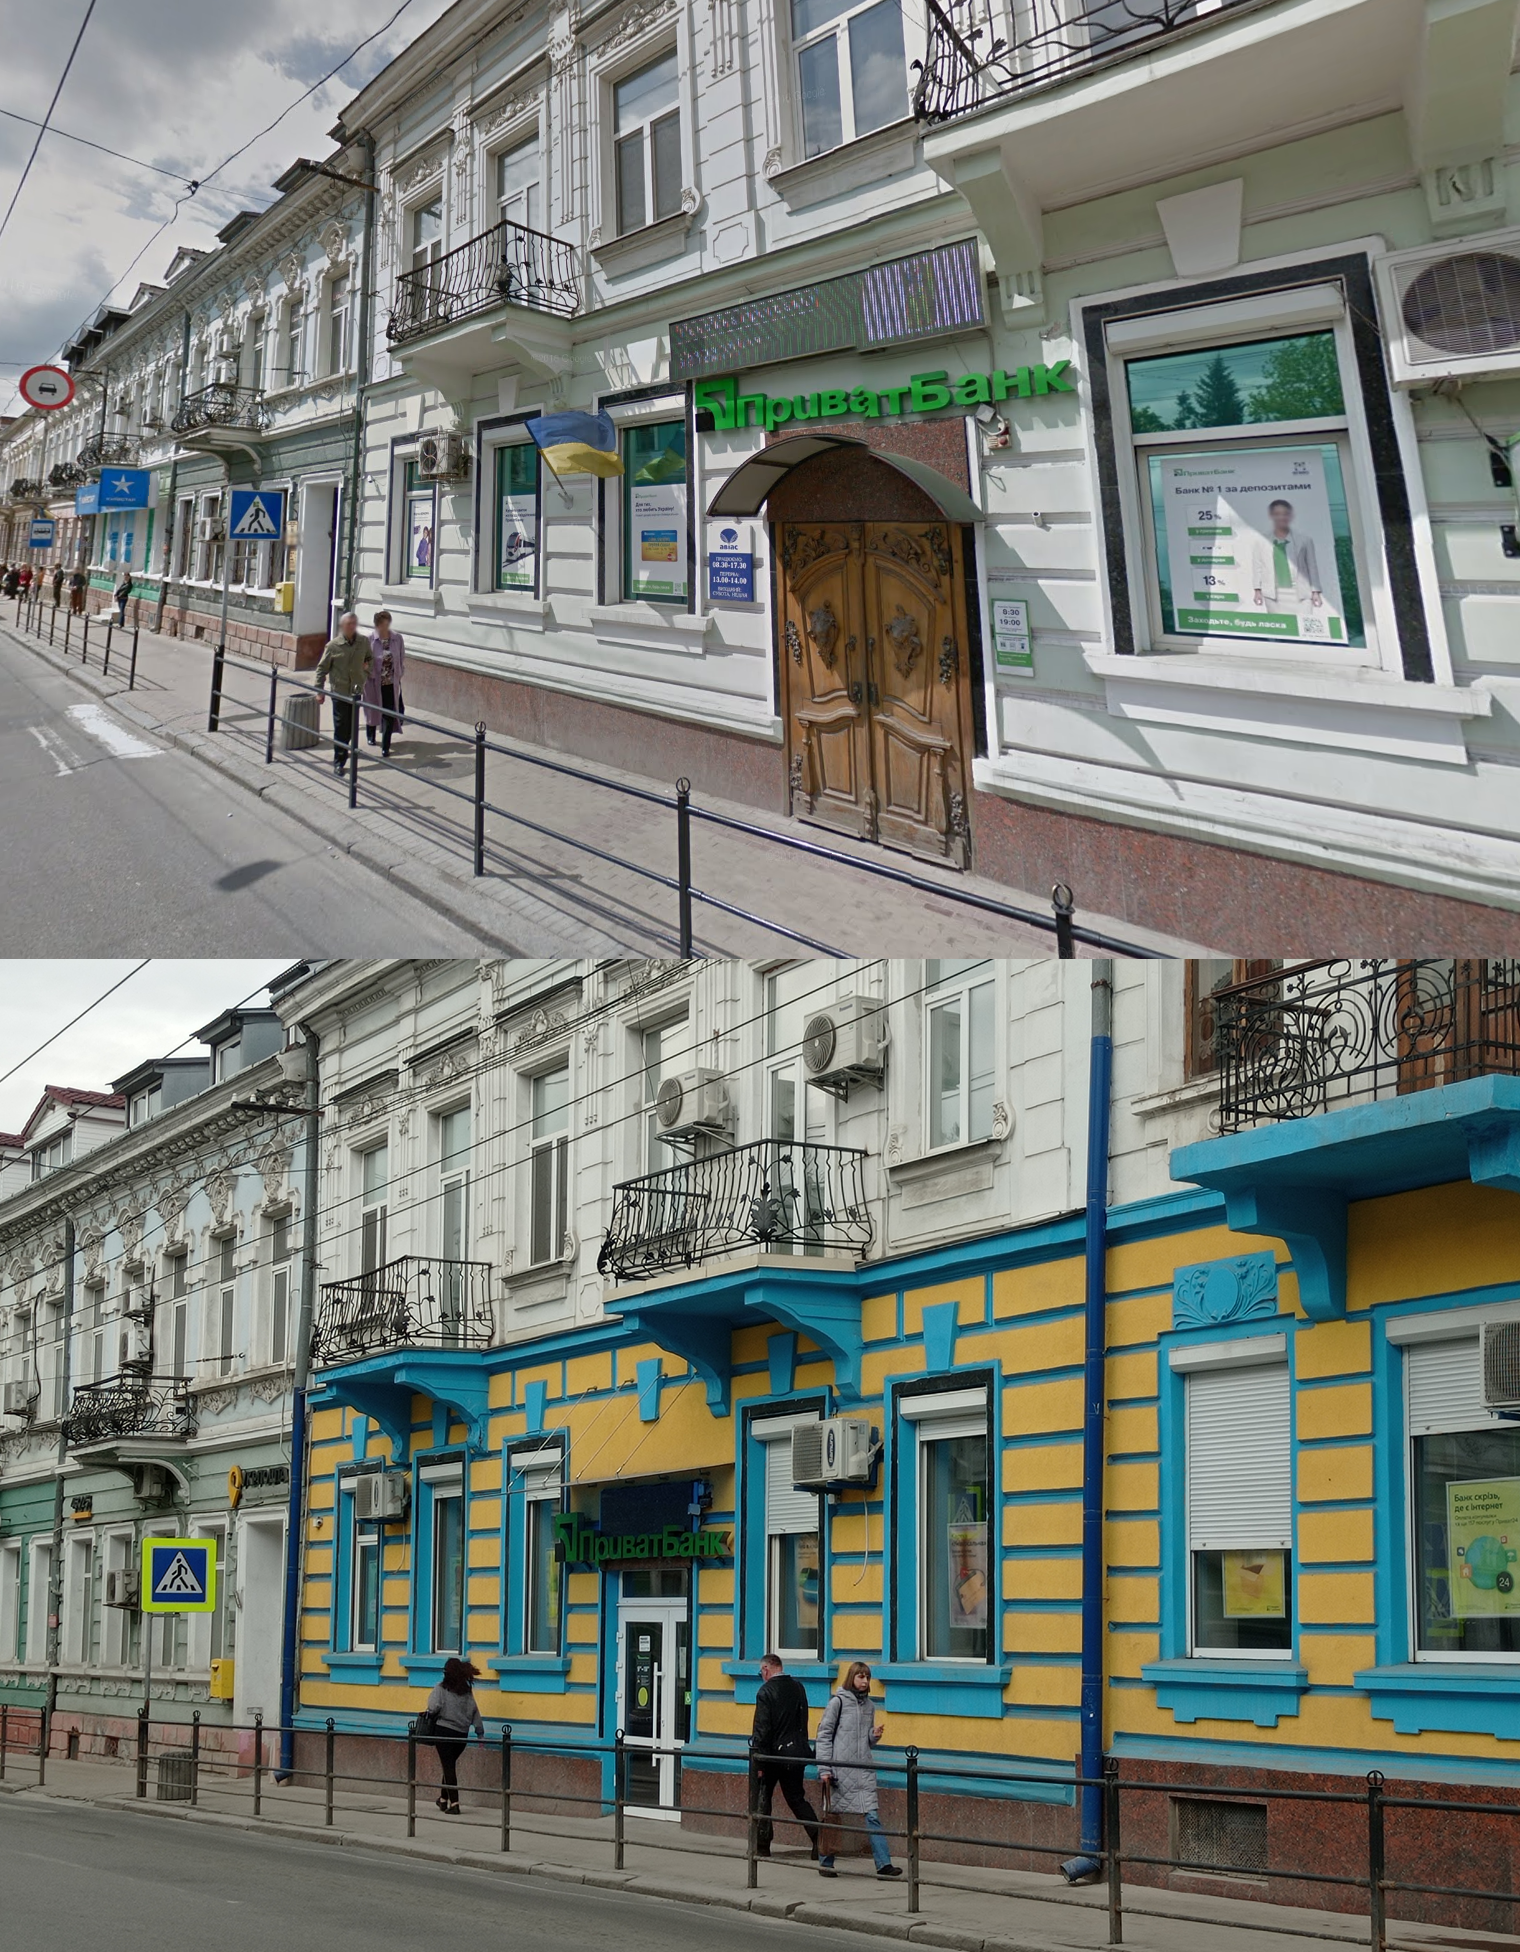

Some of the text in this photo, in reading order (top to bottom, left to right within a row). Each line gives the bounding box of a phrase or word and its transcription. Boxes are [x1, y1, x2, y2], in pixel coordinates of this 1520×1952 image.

[737, 359, 1076, 431] ПриватБанк
[1175, 486, 1200, 495] Банк
[1239, 483, 1312, 493] депозитами
[712, 561, 747, 569] 08.30-17.30
[712, 576, 747, 585] 13.00-14.00
[1002, 608, 1020, 616] 8:30
[999, 618, 1021, 626] 19:00
[1188, 616, 1287, 629] Заходьте, будь ласка
[1454, 1492, 1500, 1502] Банк скрізь,
[1455, 1505, 1464, 1513] де
[579, 1524, 727, 1567] ПриватБанк
[1499, 1577, 1510, 1587] 24
